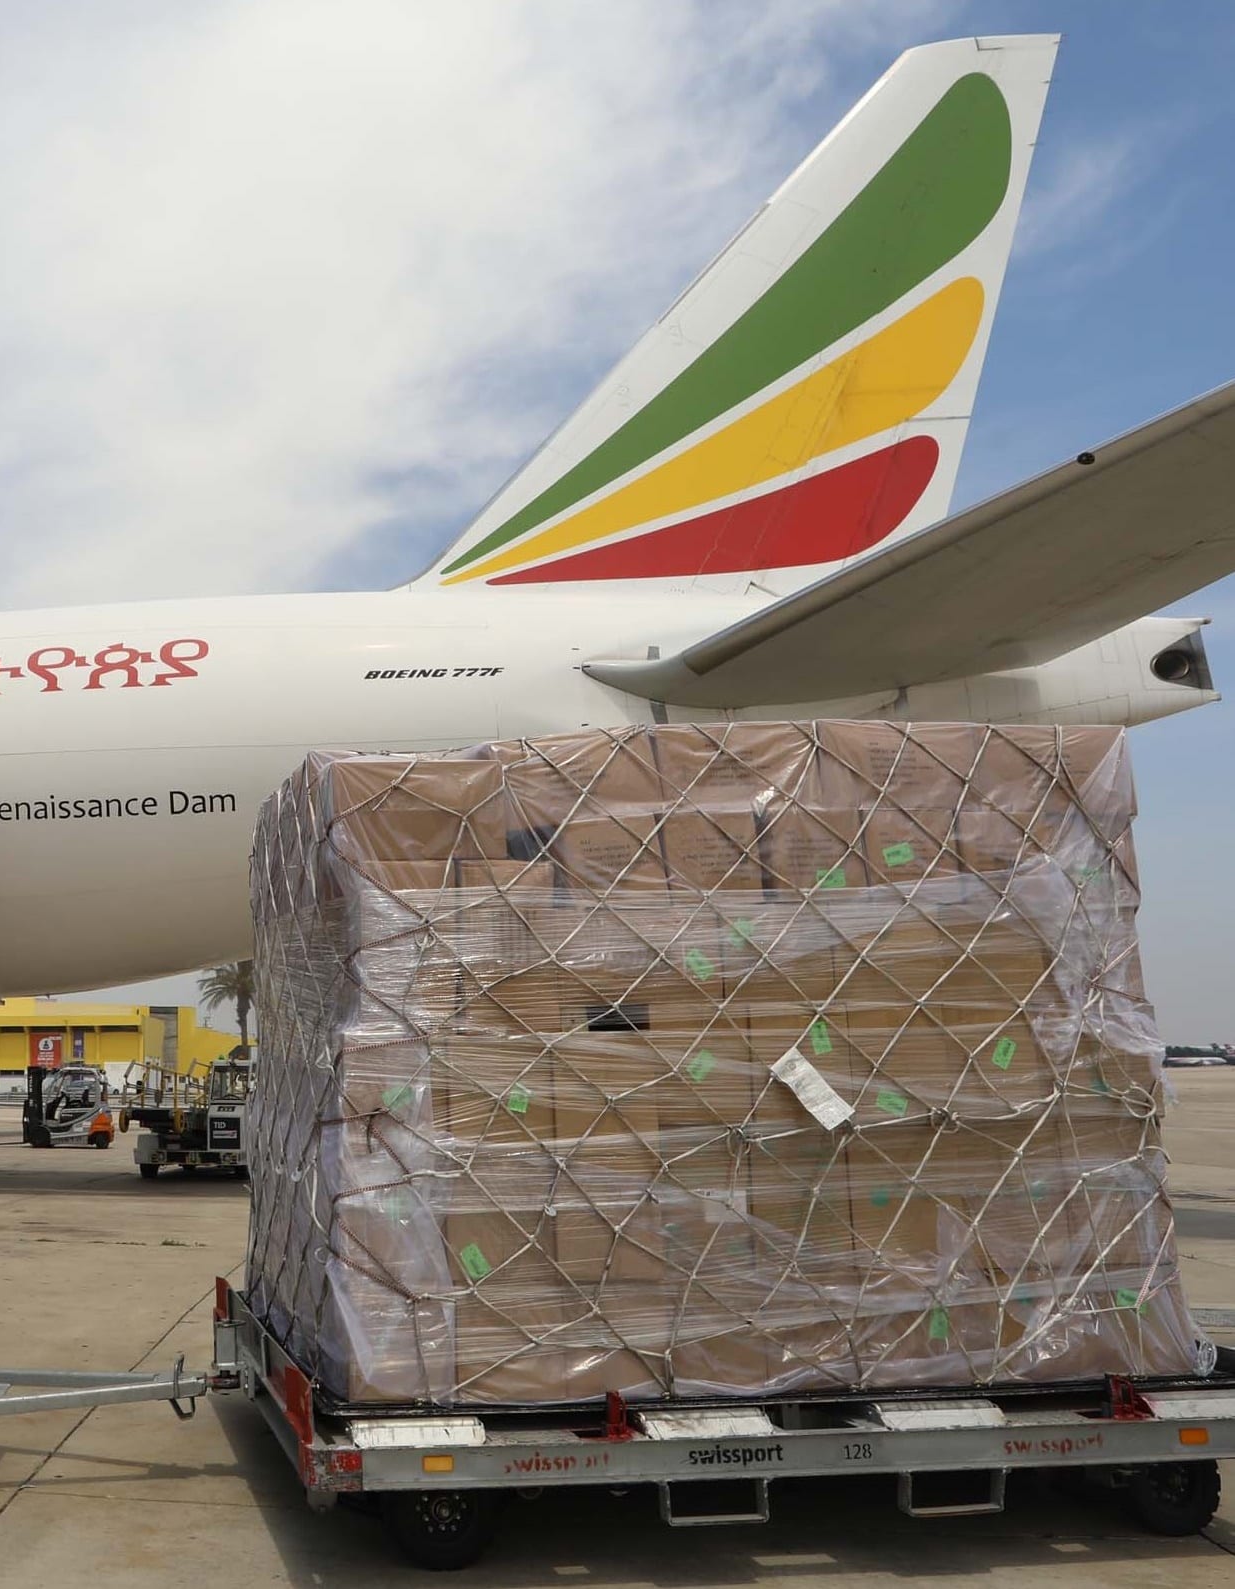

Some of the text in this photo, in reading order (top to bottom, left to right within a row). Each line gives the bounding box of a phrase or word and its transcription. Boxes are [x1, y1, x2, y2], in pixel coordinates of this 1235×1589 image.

[364, 667, 505, 680] BOEING 777F
[168, 790, 237, 815] Dam
[688, 1443, 872, 1467] swissport 128
